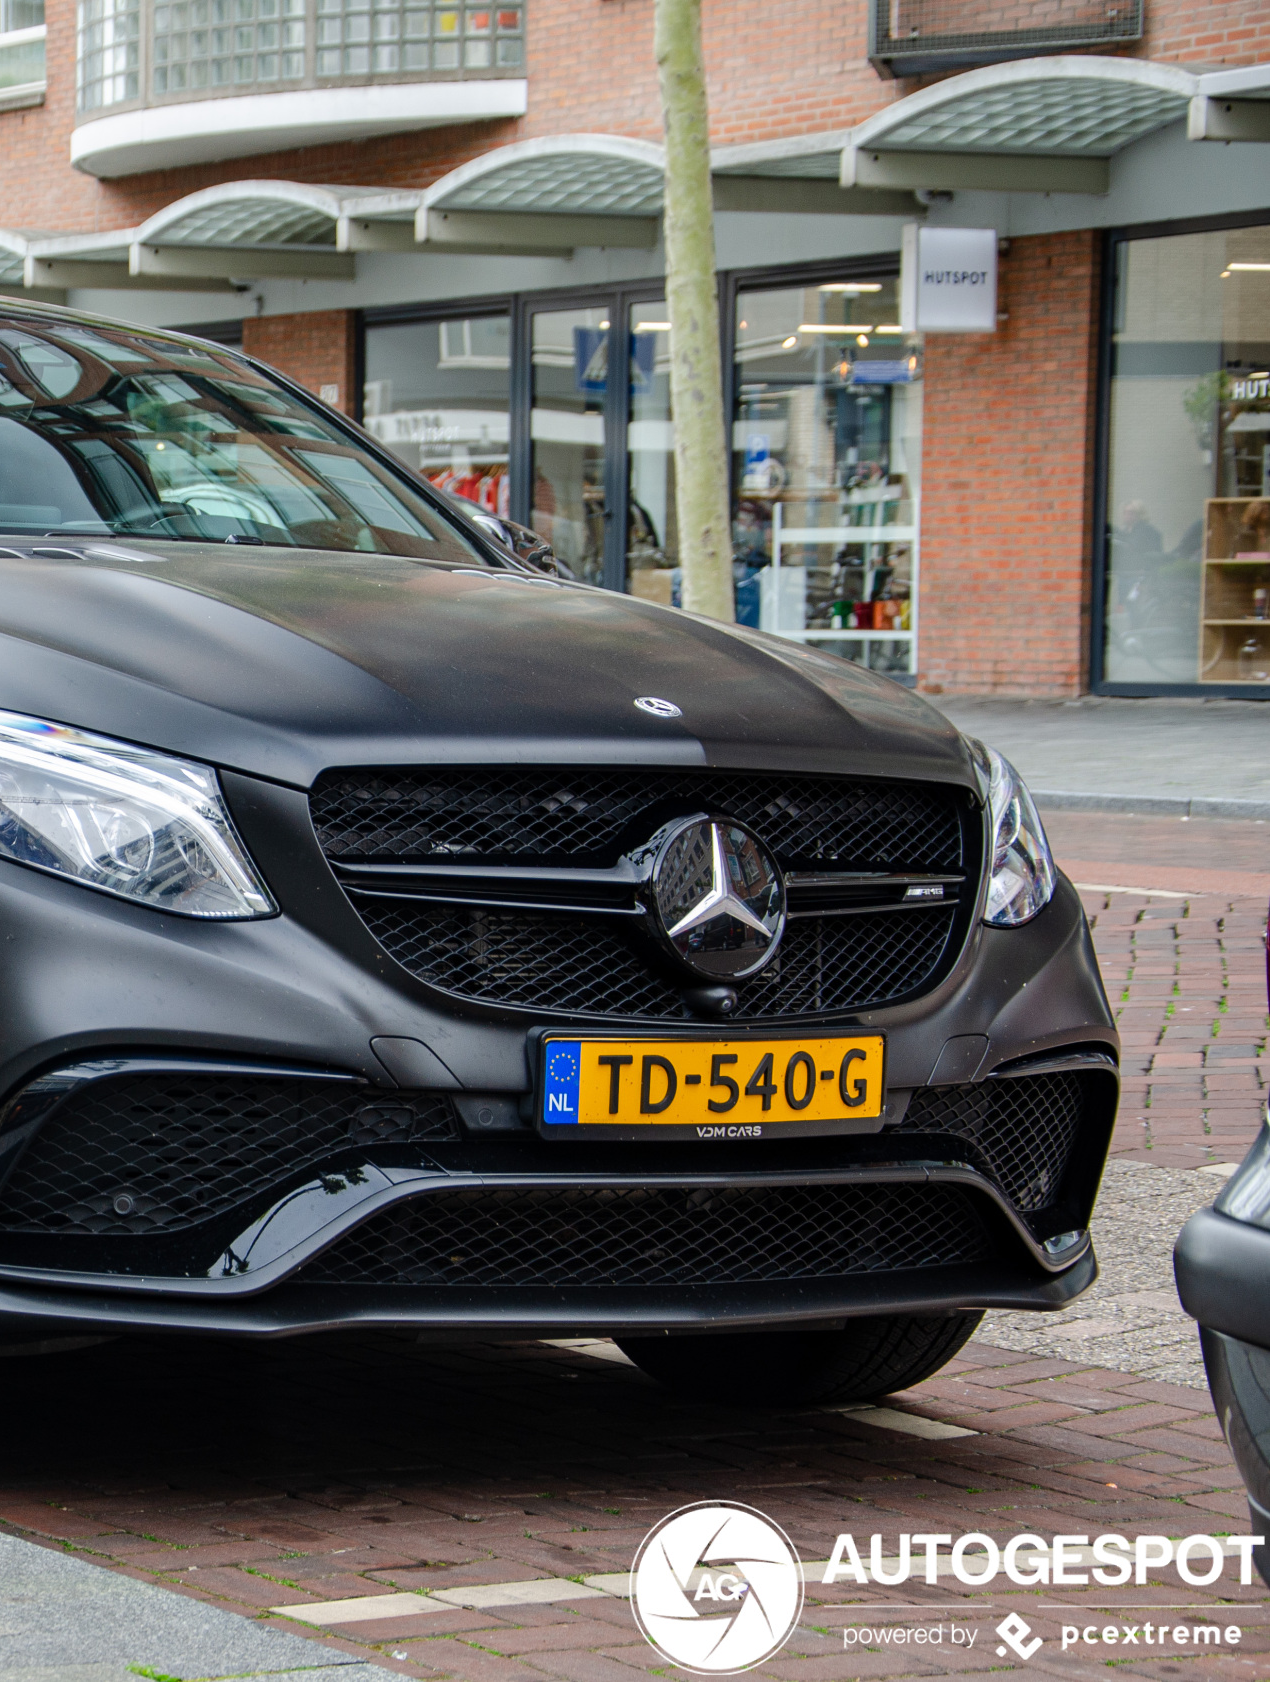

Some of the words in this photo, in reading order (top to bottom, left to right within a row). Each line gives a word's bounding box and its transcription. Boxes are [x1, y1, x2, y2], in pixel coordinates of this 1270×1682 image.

[924, 270, 988, 285] HUTSPOT
[1232, 379, 1270, 400] HUT
[598, 1047, 867, 1115] TD-540-G
[547, 1092, 574, 1112] NL
[696, 1126, 726, 1138] VDM
[727, 1125, 762, 1137] CARS
